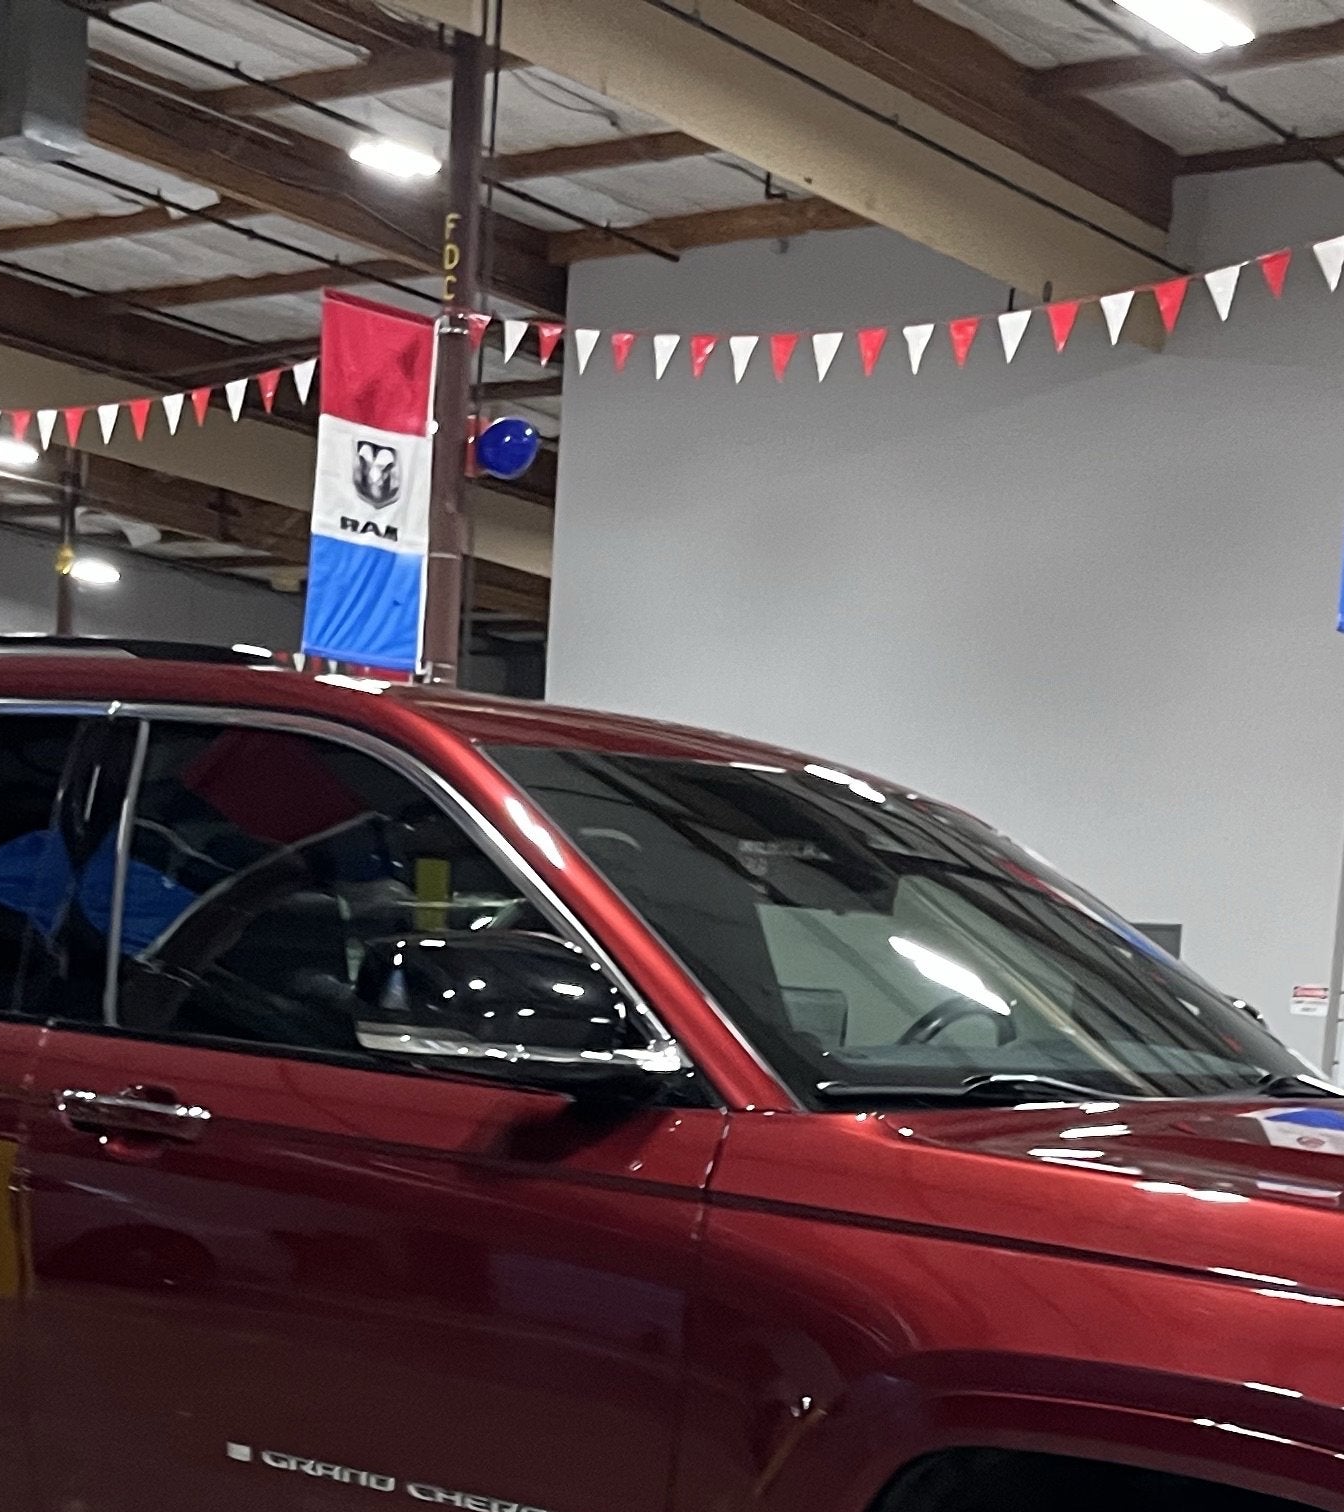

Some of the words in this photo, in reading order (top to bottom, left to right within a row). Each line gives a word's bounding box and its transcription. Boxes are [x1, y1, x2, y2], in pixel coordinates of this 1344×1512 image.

[443, 211, 462, 300] FDC
[339, 515, 398, 542] RAM
[260, 1450, 396, 1492] GRAND
